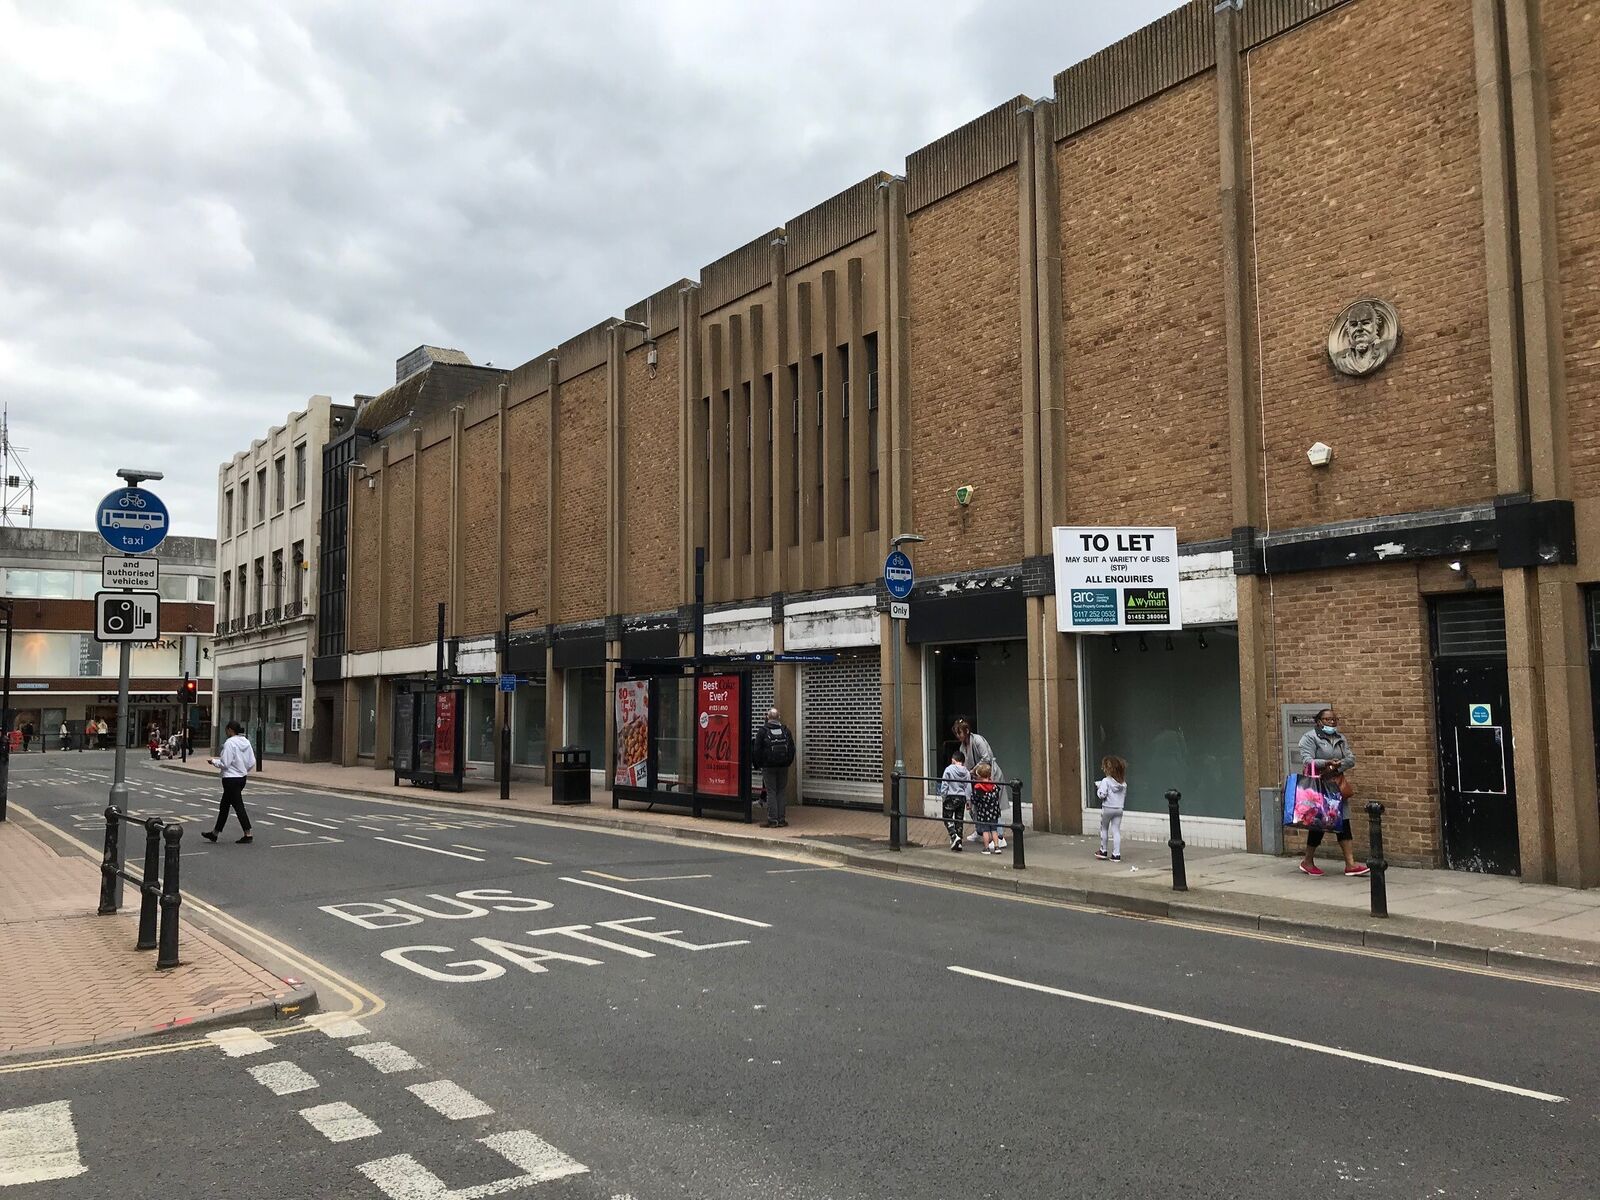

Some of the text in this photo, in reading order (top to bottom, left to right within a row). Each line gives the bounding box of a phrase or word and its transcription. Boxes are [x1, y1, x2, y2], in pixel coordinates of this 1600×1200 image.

[122, 535, 144, 546] taxi
[1080, 534, 1154, 552] TO LET
[123, 560, 140, 568] and
[107, 568, 155, 578] authorised
[112, 578, 149, 586] vehicles
[1073, 591, 1094, 603] arc
[1147, 591, 1166, 599] Kurt
[1135, 598, 1167, 607] Wyman
[893, 606, 907, 615] Only
[105, 640, 177, 649] PRMARK
[702, 681, 718, 690] Best
[98, 694, 171, 703] PRMARK
[709, 691, 728, 701] Ever?
[318, 888, 555, 930] BUS
[380, 916, 750, 983] GATE
